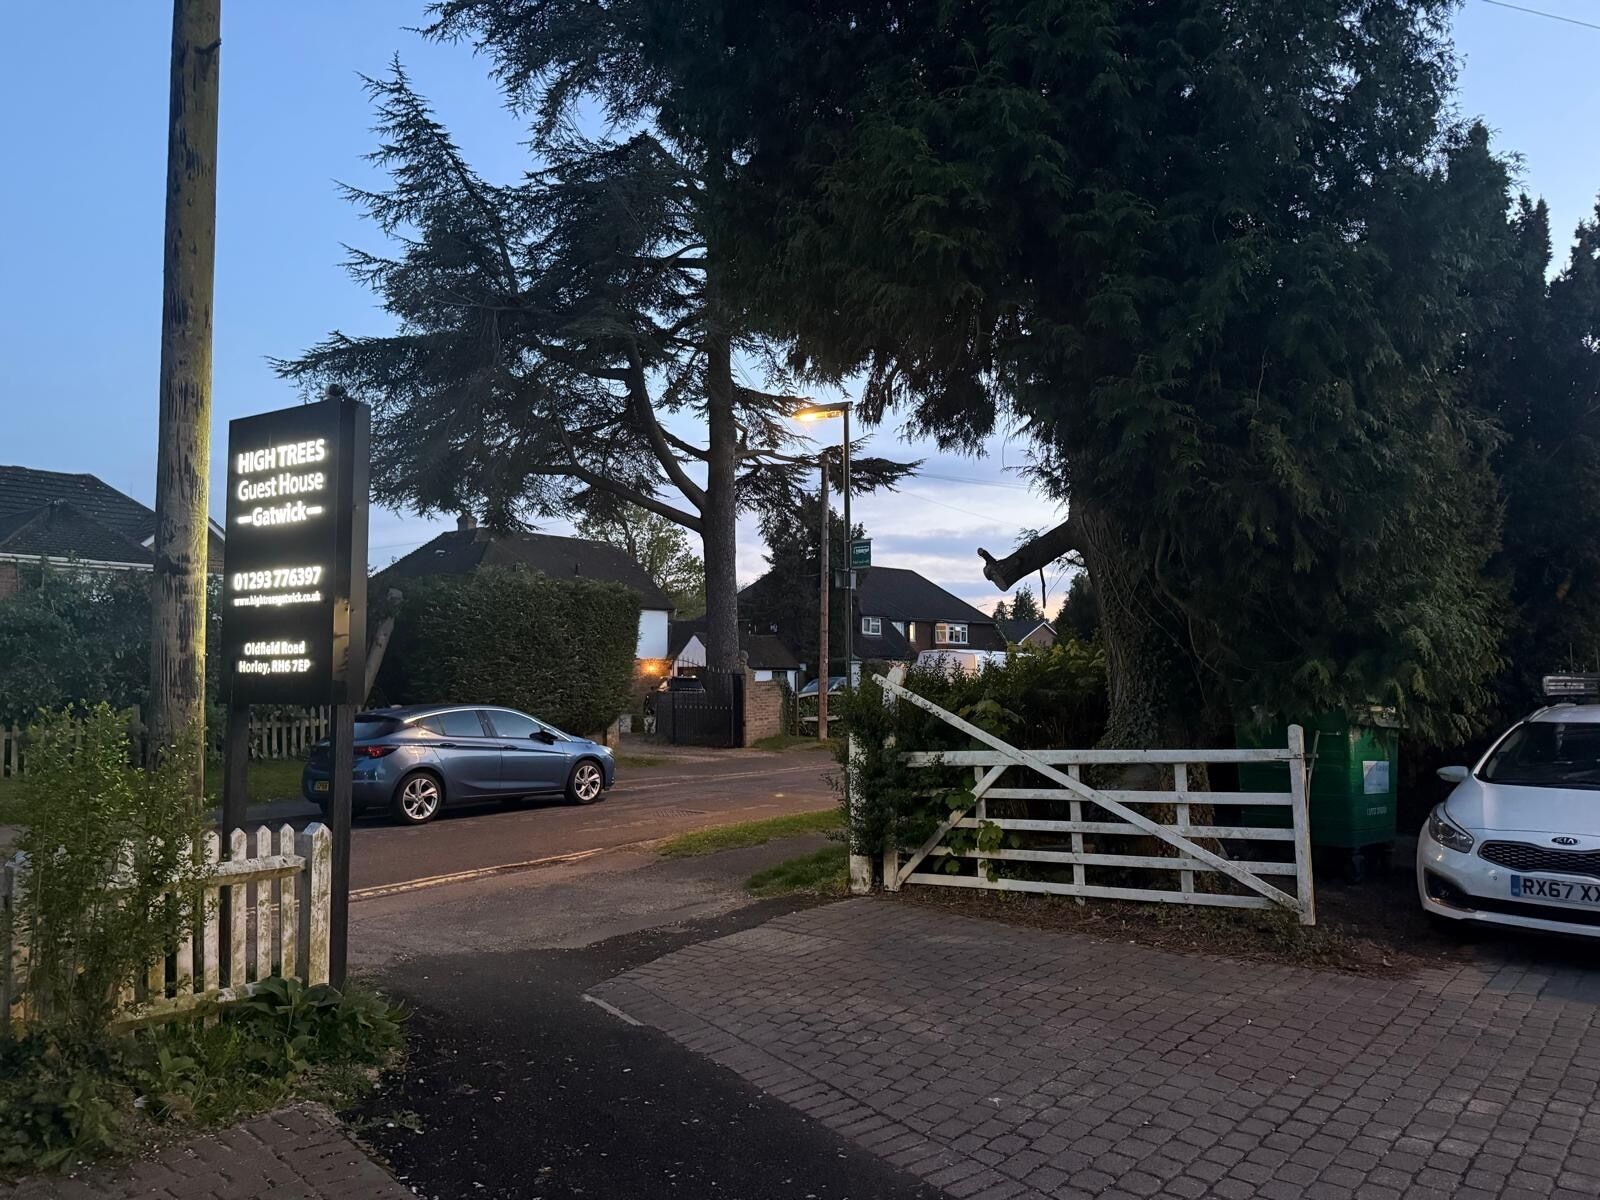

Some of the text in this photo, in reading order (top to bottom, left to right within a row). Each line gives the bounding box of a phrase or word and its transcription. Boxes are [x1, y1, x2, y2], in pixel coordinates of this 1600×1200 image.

[237, 438, 325, 474] HIGH TREES
[237, 472, 324, 501] Guest House
[233, 566, 322, 590] 01293 776397
[244, 640, 306, 655] Oldfield Road
[238, 659, 311, 675] Horley, RH6 7EP
[1522, 878, 1574, 899] RX67
